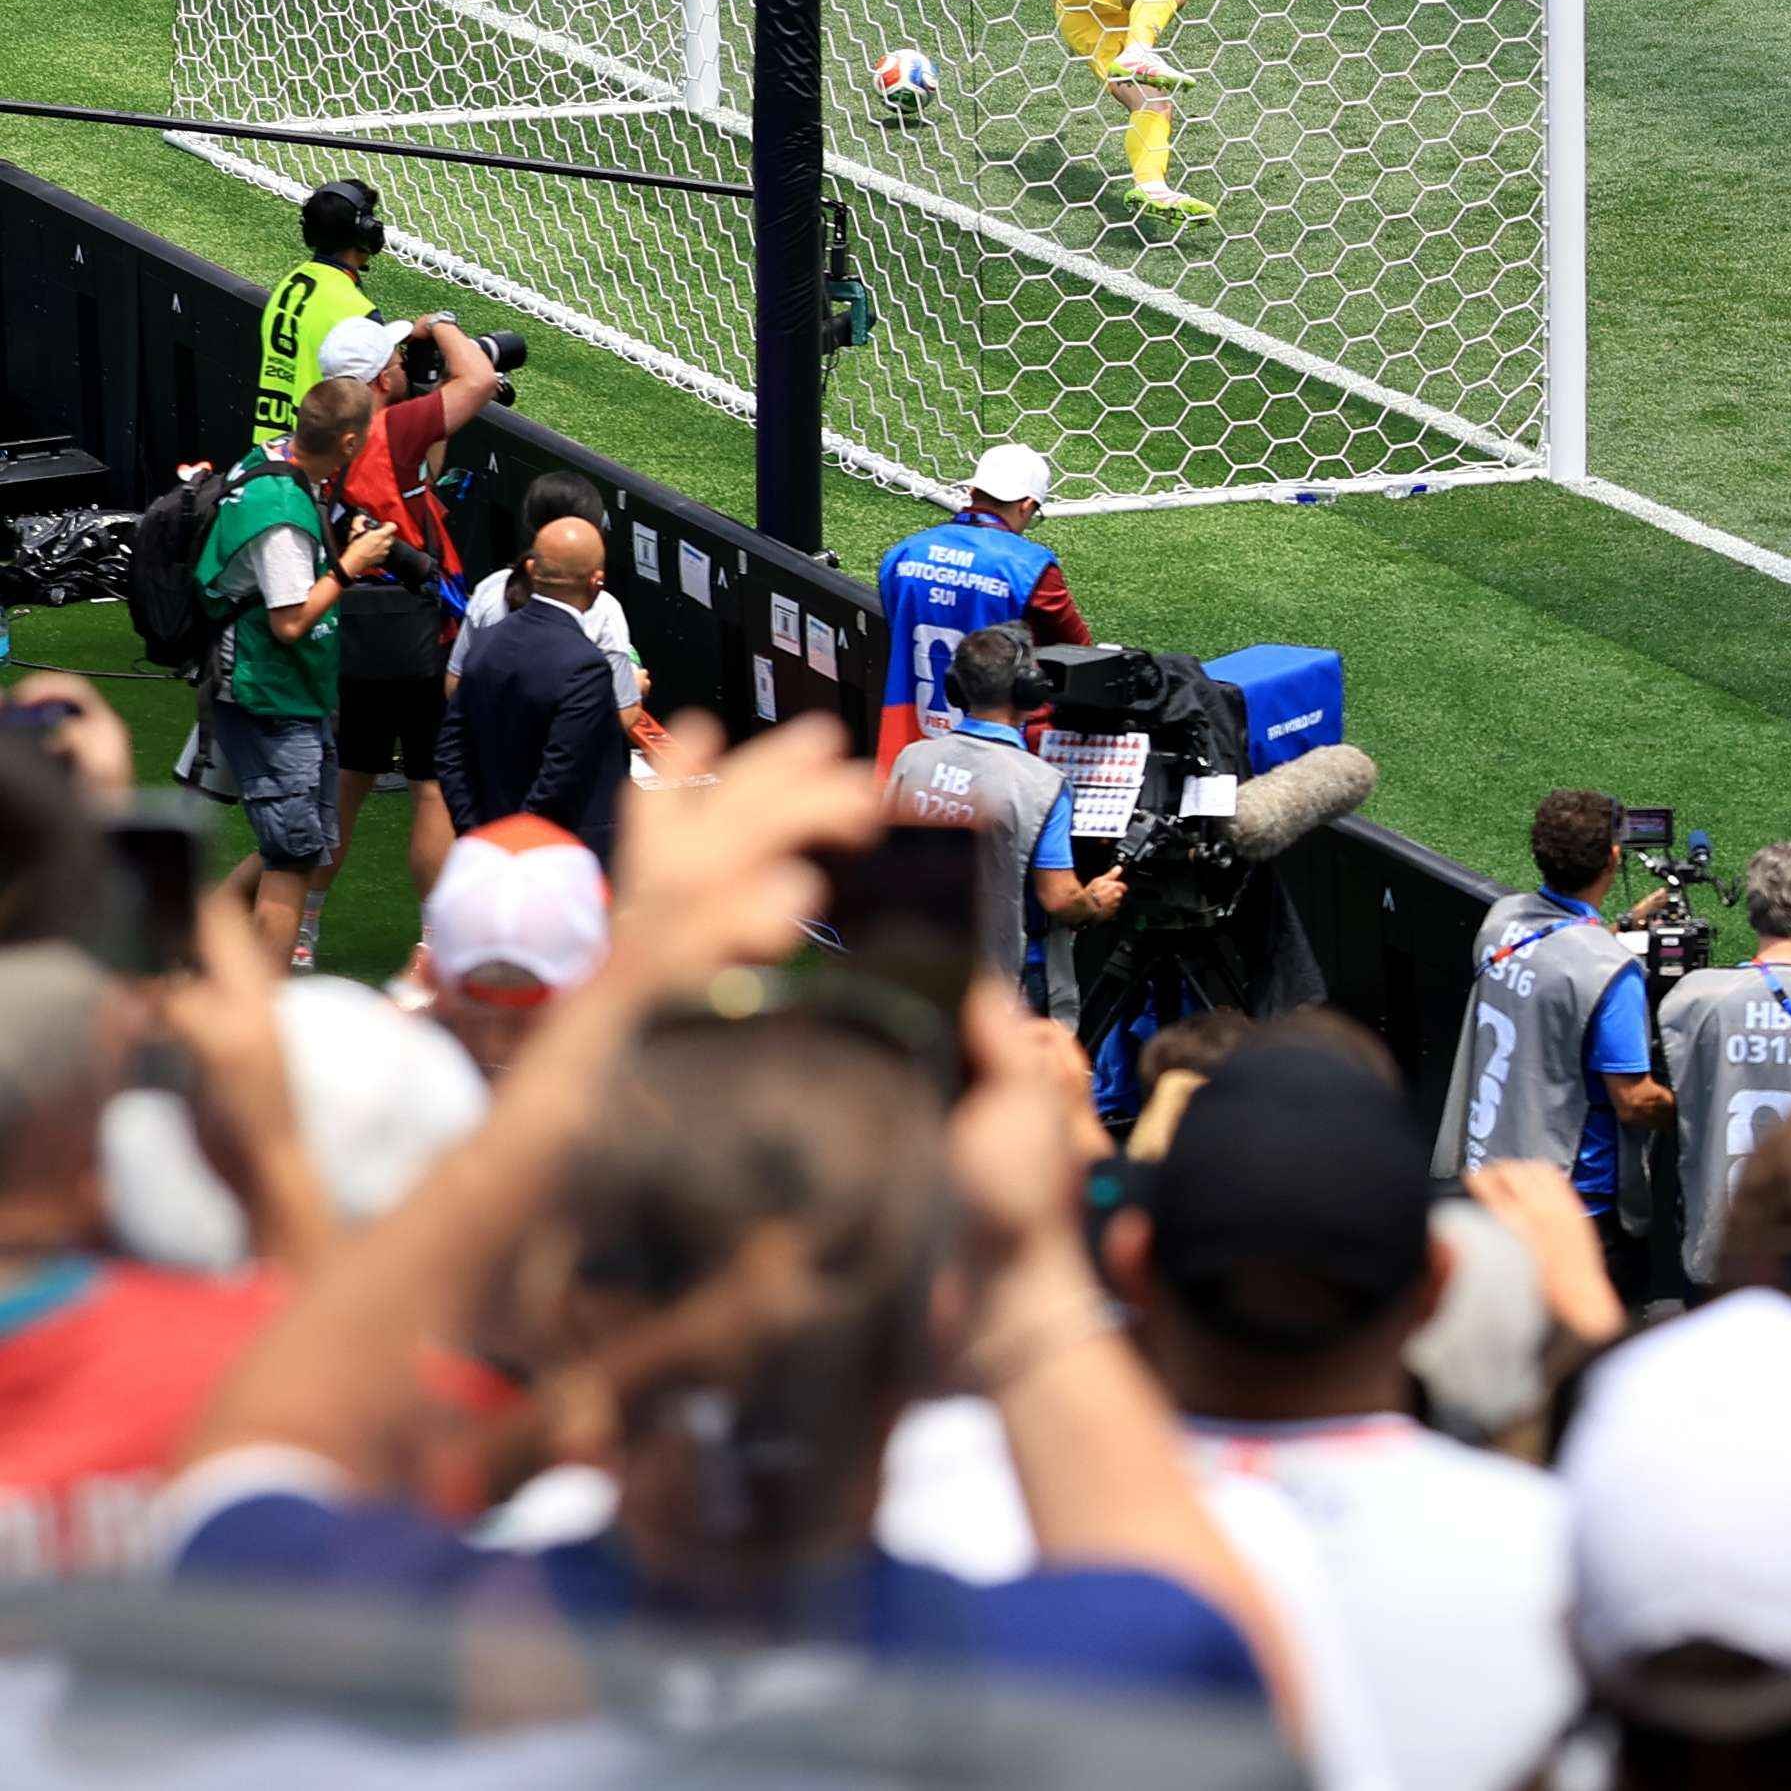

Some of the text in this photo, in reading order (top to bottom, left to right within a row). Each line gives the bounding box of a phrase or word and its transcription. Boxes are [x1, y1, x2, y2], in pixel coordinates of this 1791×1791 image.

[928, 544, 975, 569] TEAM
[897, 561, 1010, 598] HOTOGRAPHER
[928, 586, 957, 607] SUI
[930, 762, 973, 796] HB
